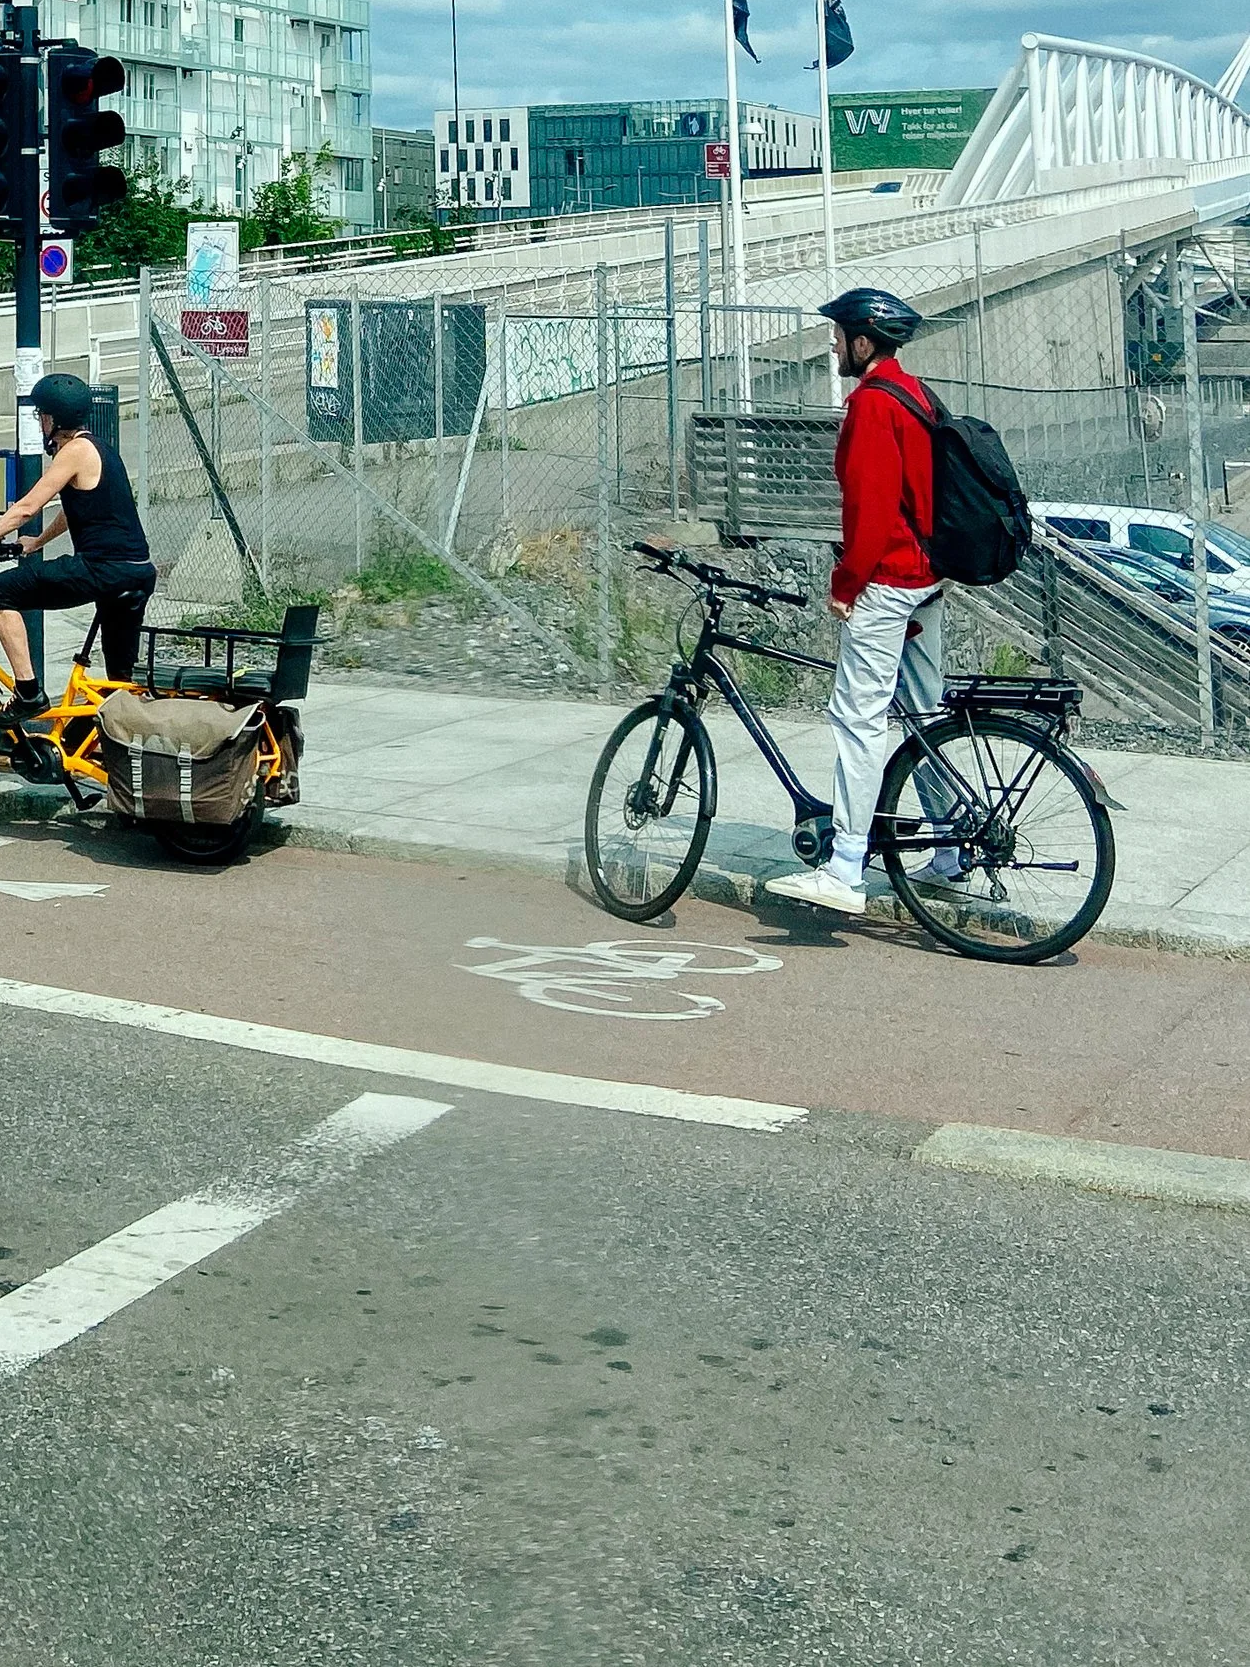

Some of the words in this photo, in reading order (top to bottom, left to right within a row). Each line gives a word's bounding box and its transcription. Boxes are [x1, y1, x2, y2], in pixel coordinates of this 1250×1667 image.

[900, 107, 922, 116] Hver
[901, 122, 922, 131] Takk
[922, 121, 935, 130] for
[936, 122, 946, 130] at
[946, 121, 958, 130] du
